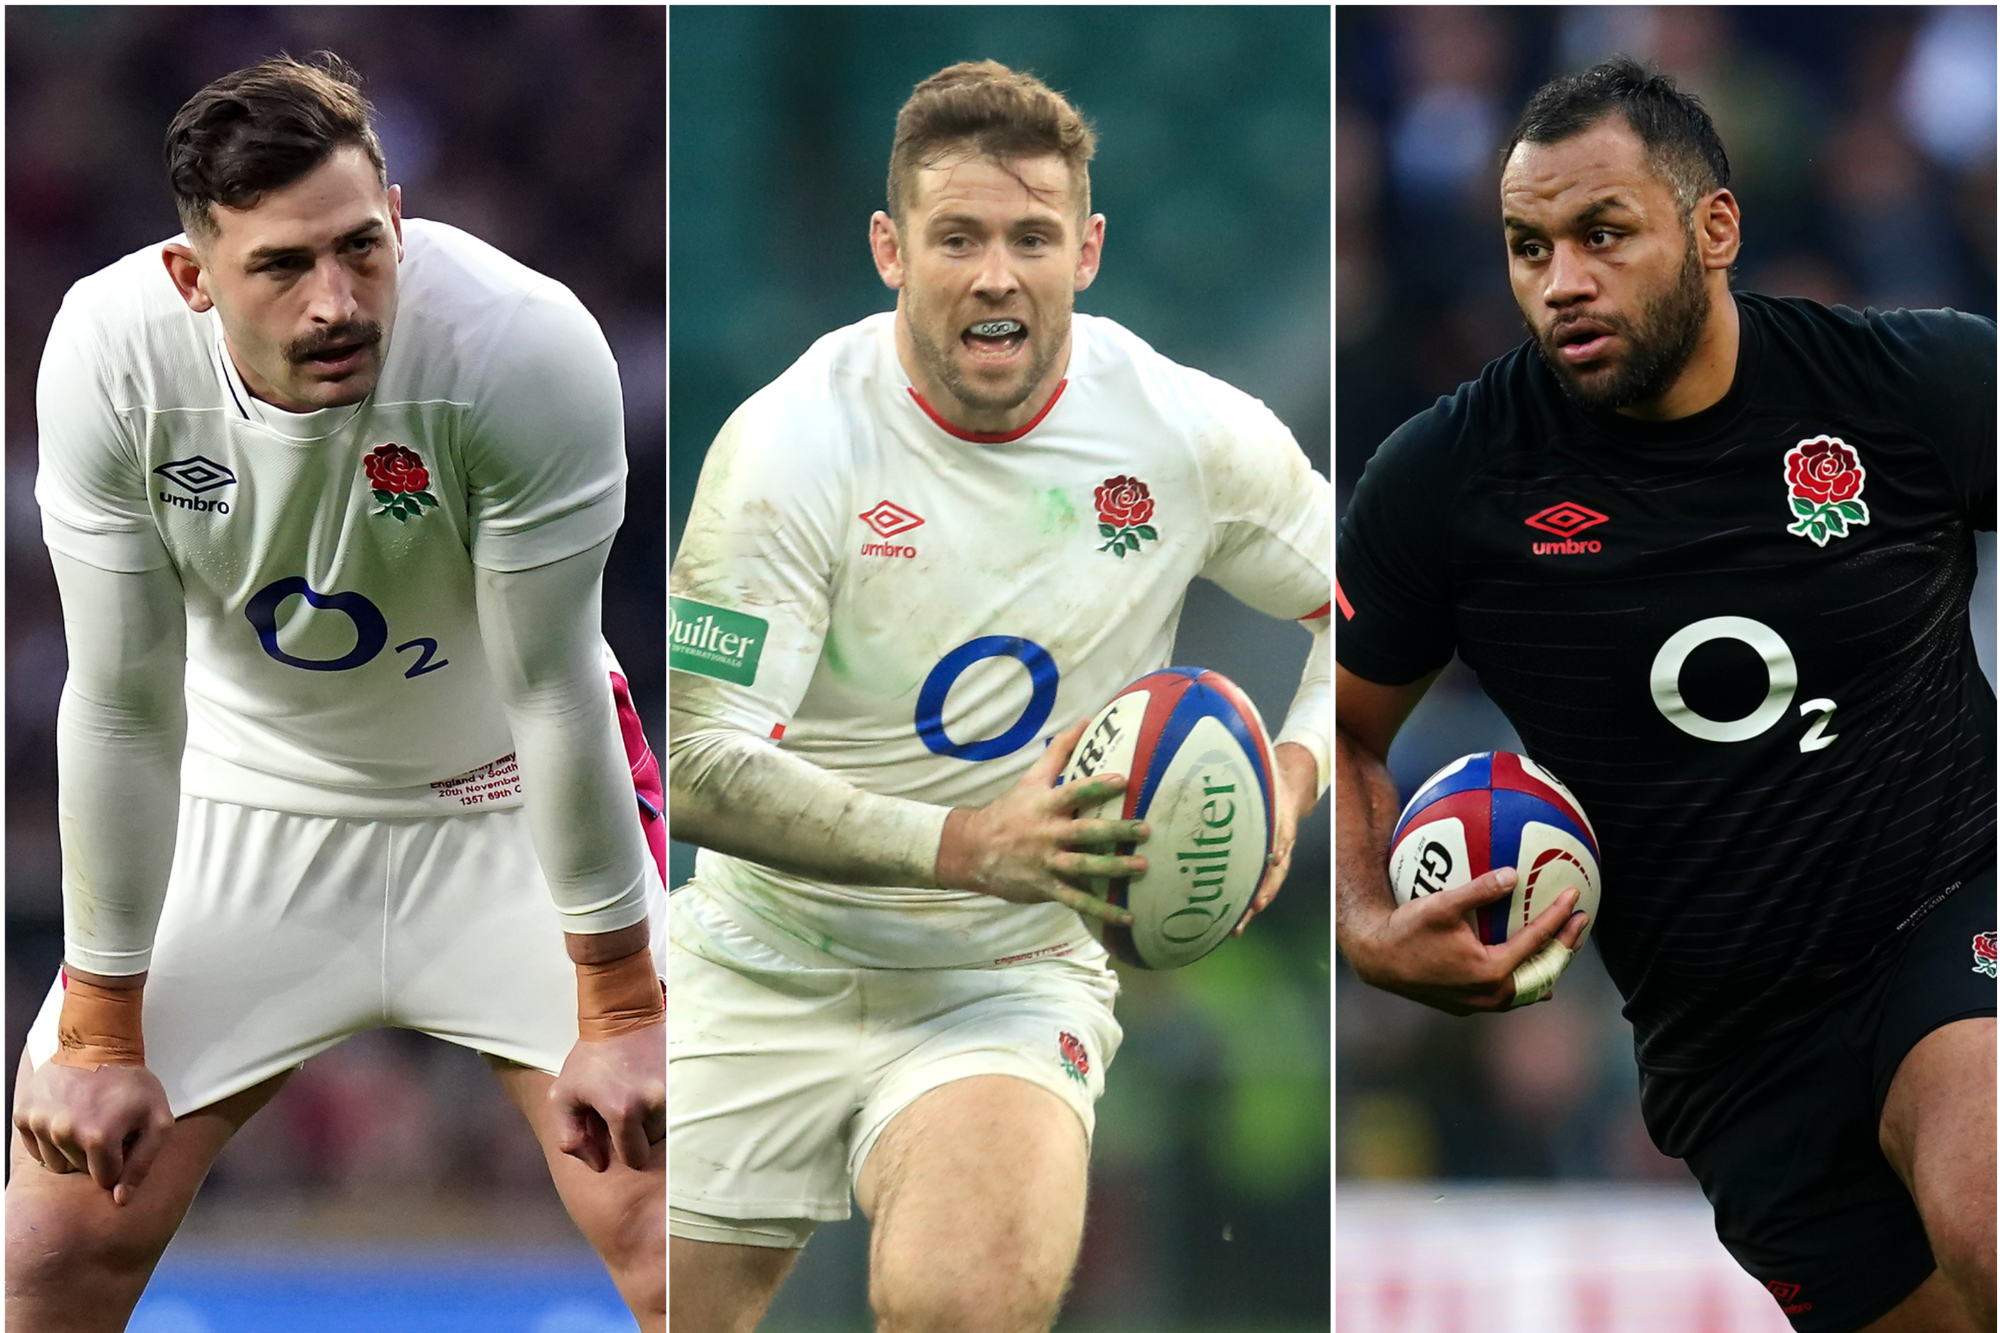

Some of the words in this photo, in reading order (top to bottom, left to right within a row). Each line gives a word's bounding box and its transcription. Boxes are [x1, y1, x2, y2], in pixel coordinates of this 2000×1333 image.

[159, 491, 230, 515] umbro
[861, 540, 917, 559] umbro
[1532, 538, 1602, 556] umbro
[244, 576, 450, 680] O2
[1650, 615, 1840, 754] O2
[430, 775, 476, 789] England
[487, 762, 518, 779] South
[438, 787, 463, 798] 20th
[487, 788, 512, 801] 69th
[1161, 775, 1237, 944] Quilter
[1410, 840, 1453, 901] GI
